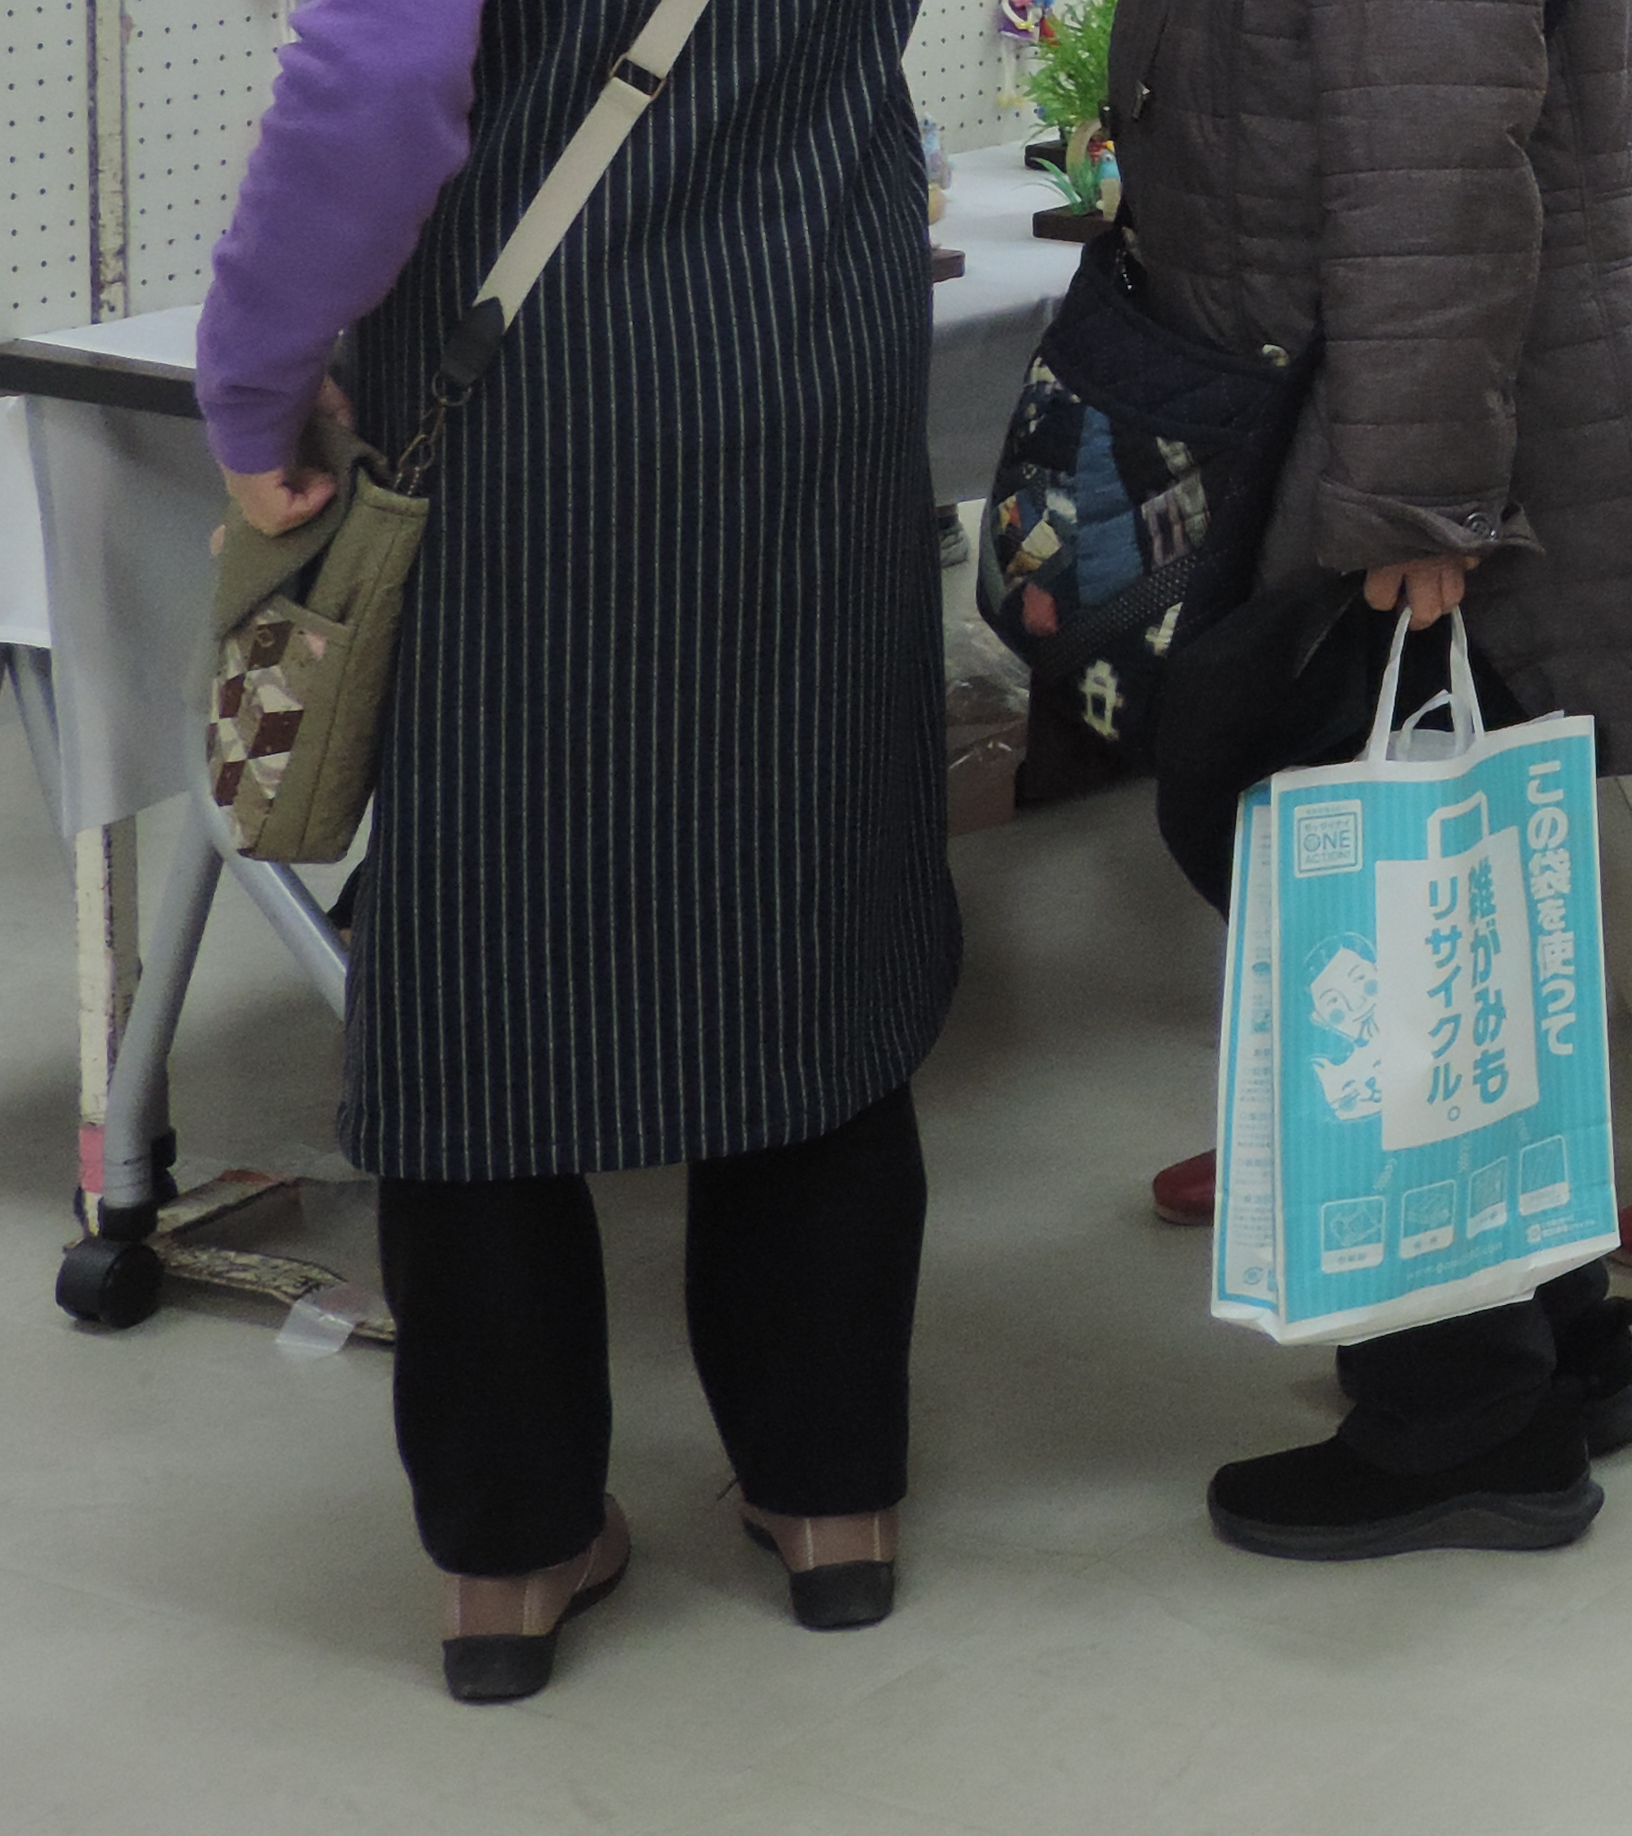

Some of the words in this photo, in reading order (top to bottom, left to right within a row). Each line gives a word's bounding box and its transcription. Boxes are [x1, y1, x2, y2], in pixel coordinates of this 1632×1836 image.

[1303, 829, 1351, 853] ONE
[1527, 760, 1576, 1056] この袋を使って
[1424, 875, 1463, 1121] リサイクル。
[1468, 855, 1509, 1105] 雑がみも
